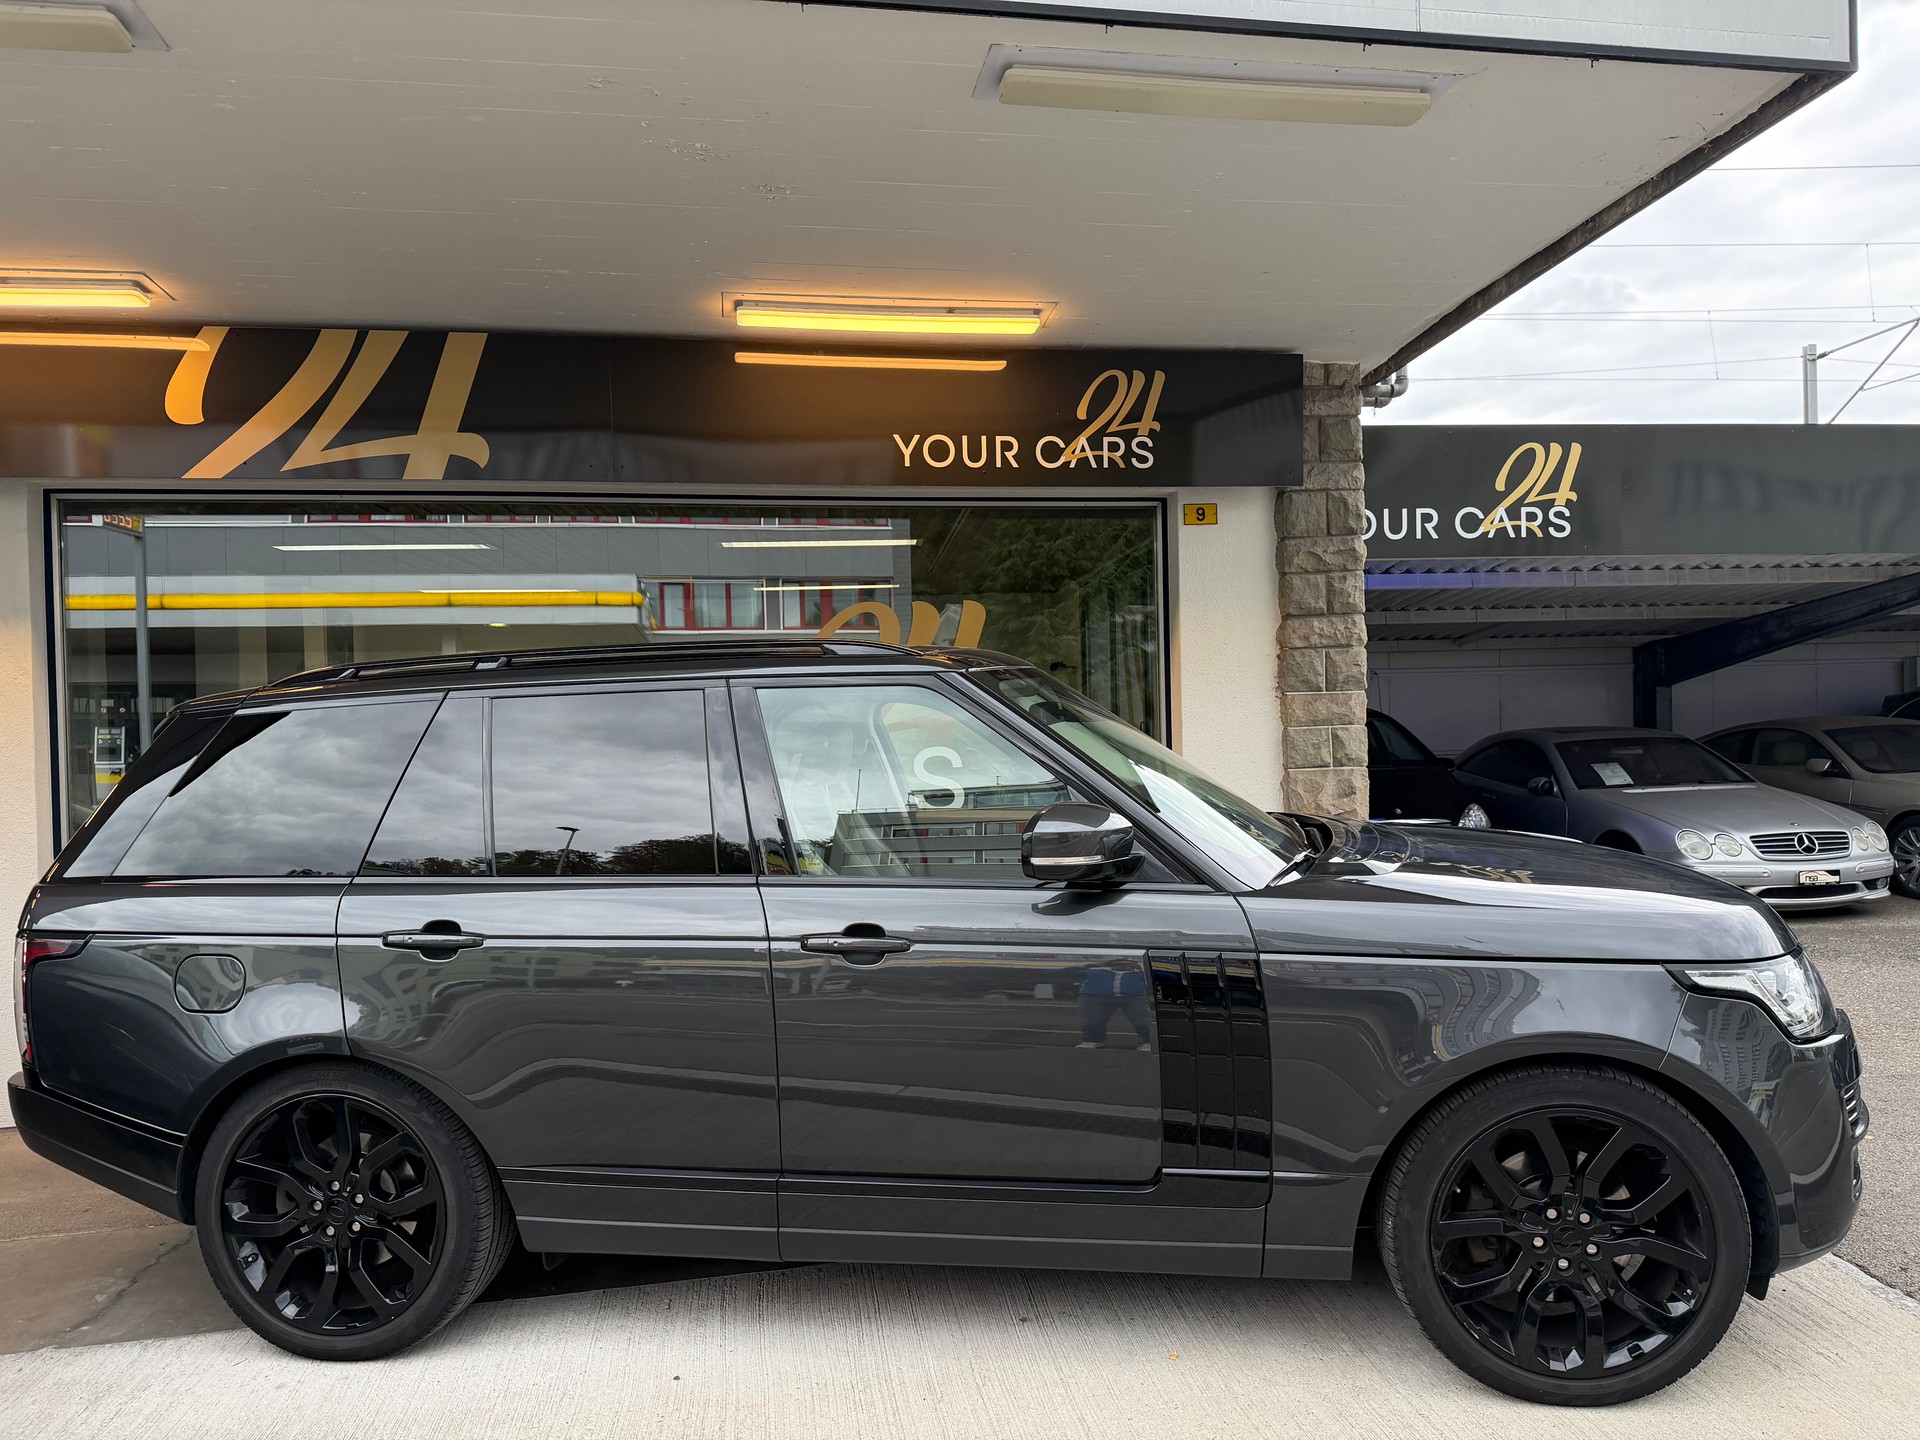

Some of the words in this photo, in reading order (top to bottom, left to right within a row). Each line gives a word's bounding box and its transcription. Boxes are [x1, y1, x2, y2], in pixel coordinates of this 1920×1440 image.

[1062, 369, 1166, 468] 24
[893, 433, 1019, 468] YOUR
[1035, 435, 1155, 469] CARS
[1482, 442, 1582, 538] 24
[1196, 507, 1206, 521] 9
[1454, 506, 1572, 539] CARS
